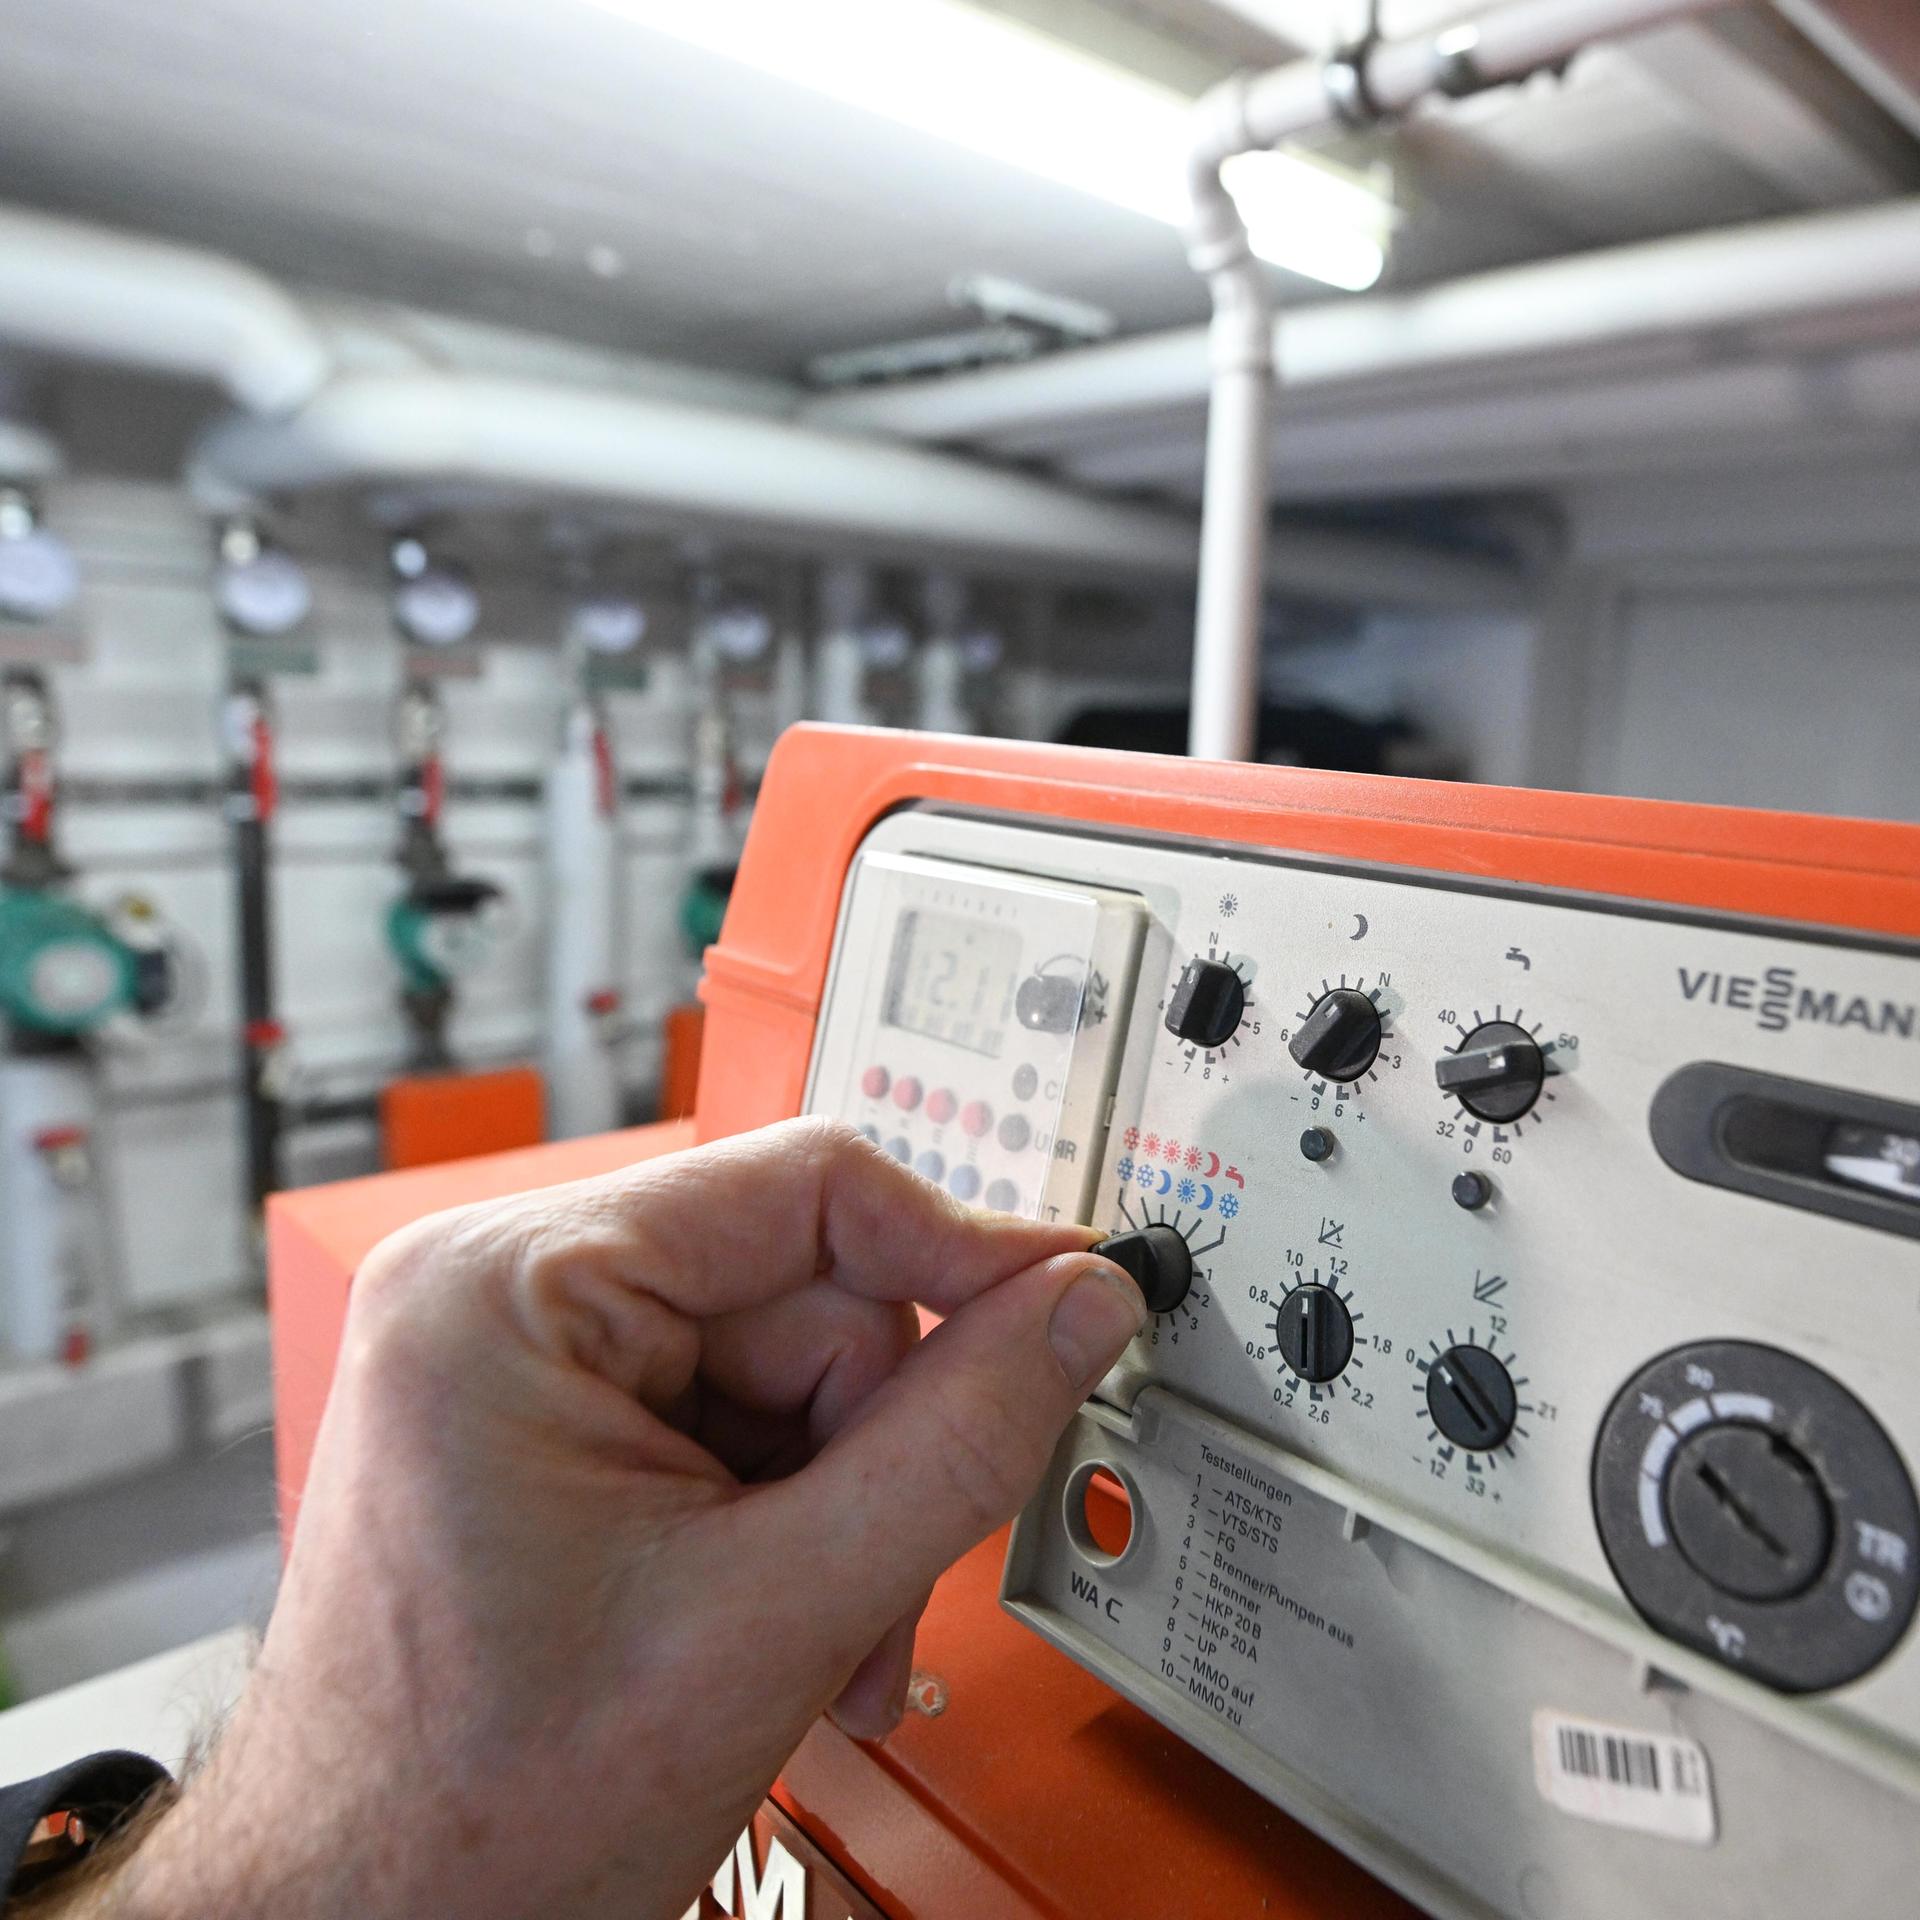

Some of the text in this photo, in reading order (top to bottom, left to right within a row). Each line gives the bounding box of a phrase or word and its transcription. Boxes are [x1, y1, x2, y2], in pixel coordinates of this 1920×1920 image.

[1209, 932, 1219, 945] N
[1379, 972, 1391, 987] N
[1678, 966, 1920, 1041] VIESSMAN
[1437, 1008, 1456, 1025] 40
[1253, 1022, 1261, 1035] 5
[1280, 1029, 1289, 1042] 6
[1558, 1033, 1579, 1050] 50
[1183, 1062, 1191, 1074] 7
[1203, 1067, 1211, 1080] 8
[1392, 1055, 1402, 1070] 3
[1311, 1097, 1320, 1110] 9
[1334, 1104, 1344, 1118] 6
[1436, 1121, 1455, 1139] 32
[1464, 1139, 1473, 1154] 0
[1492, 1147, 1512, 1165] 60
[1286, 1249, 1303, 1266] 1,0
[1329, 1256, 1348, 1275] 1,2
[1207, 1268, 1213, 1281] 1
[1201, 1294, 1210, 1308] 2
[1249, 1285, 1268, 1304] 0,8
[1190, 1317, 1198, 1330] 3
[1490, 1315, 1507, 1334] 12
[1151, 1333, 1159, 1345] 5
[1171, 1332, 1179, 1344] 4
[1372, 1335, 1392, 1354] 1,8
[1245, 1341, 1265, 1361] 0,6
[1406, 1349, 1415, 1363] 0
[1273, 1388, 1294, 1408] 0,2
[1351, 1388, 1374, 1409] 2,2
[1308, 1404, 1330, 1424] 2,6
[1537, 1401, 1557, 1421] 21
[1200, 1444, 1292, 1506] Teststellungen
[1430, 1459, 1446, 1479] 12
[1465, 1475, 1486, 1497] 33
[1196, 1474, 1202, 1488] 1
[1225, 1490, 1283, 1532] ATS/KTS
[1191, 1494, 1199, 1509] 2
[1222, 1510, 1279, 1554] VTS/STS
[1186, 1515, 1195, 1529] 3
[1217, 1531, 1236, 1553] FG
[1071, 1570, 1098, 1609] WA
[1179, 1555, 1187, 1570] 5
[1209, 1574, 1262, 1615] Brenner
[1183, 1536, 1191, 1550] 4
[1213, 1551, 1325, 1631] Brenner/Pumpen
[1328, 1623, 1354, 1649] aus
[1175, 1576, 1184, 1591] 6
[1205, 1594, 1233, 1620] HKP
[1171, 1596, 1180, 1610] 7
[1201, 1615, 1229, 1641] HKP
[1167, 1617, 1175, 1631] 8
[1197, 1635, 1217, 1657] UP
[1163, 1638, 1171, 1652] 9
[1193, 1656, 1229, 1691] MMO
[1231, 1685, 1255, 1708] auf
[1160, 1659, 1174, 1677] 10
[1189, 1677, 1225, 1713] MMO
[1227, 1709, 1242, 1726] zu
